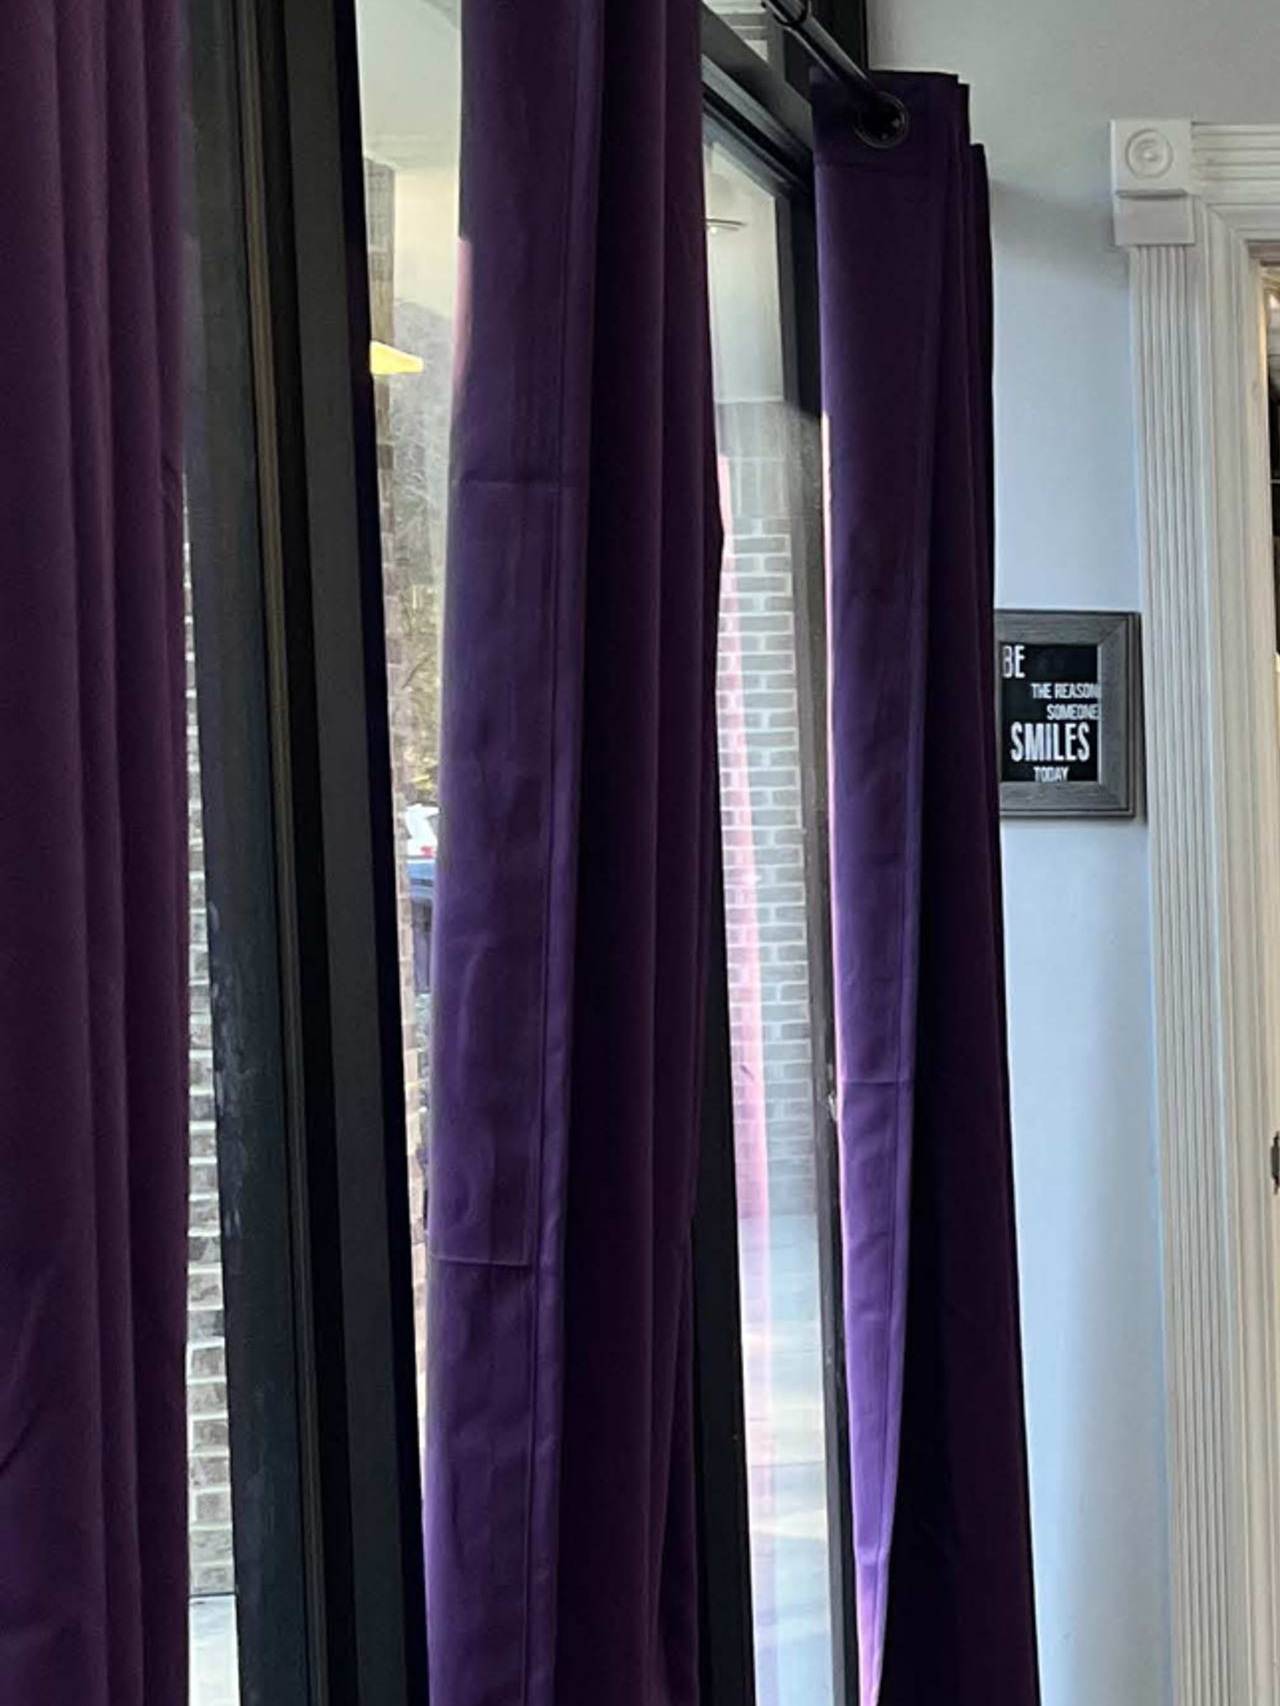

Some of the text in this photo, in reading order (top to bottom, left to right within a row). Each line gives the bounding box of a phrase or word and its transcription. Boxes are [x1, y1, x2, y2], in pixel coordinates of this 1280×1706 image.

[1002, 644, 1026, 679] BE
[1031, 682, 1100, 699] THE REASON
[1046, 703, 1100, 720] SOMEONE
[1010, 721, 1091, 762] SMILES
[1033, 766, 1069, 782] TODAY
